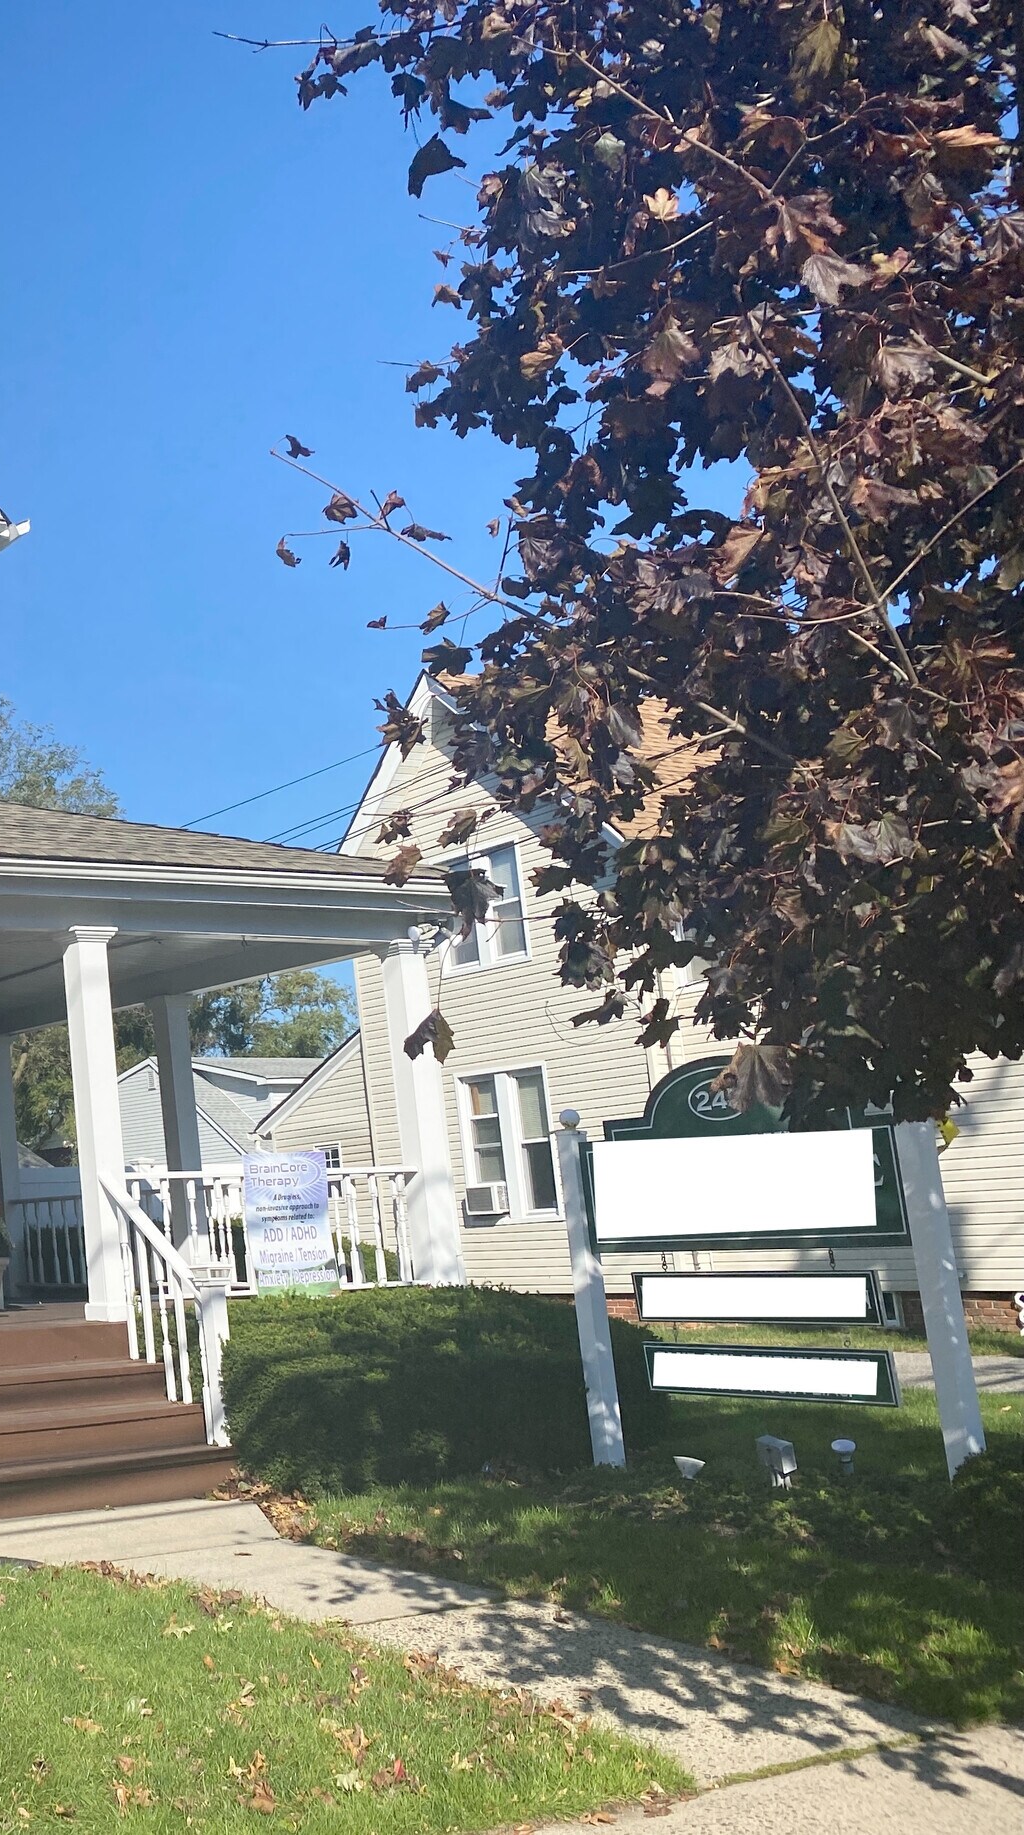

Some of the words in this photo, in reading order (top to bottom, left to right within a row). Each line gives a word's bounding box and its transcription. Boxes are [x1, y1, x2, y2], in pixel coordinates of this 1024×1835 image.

[694, 1088, 730, 1113] 24
[249, 1162, 308, 1174] BrainCore
[250, 1176, 299, 1187] Therapy
[289, 1203, 314, 1211] approach
[263, 1227, 284, 1242] ADD
[291, 1225, 318, 1241] ADHD
[259, 1247, 294, 1268] Migraine
[298, 1245, 328, 1262] Tension
[258, 1268, 289, 1288] Anxiety
[293, 1264, 336, 1286] Depression
